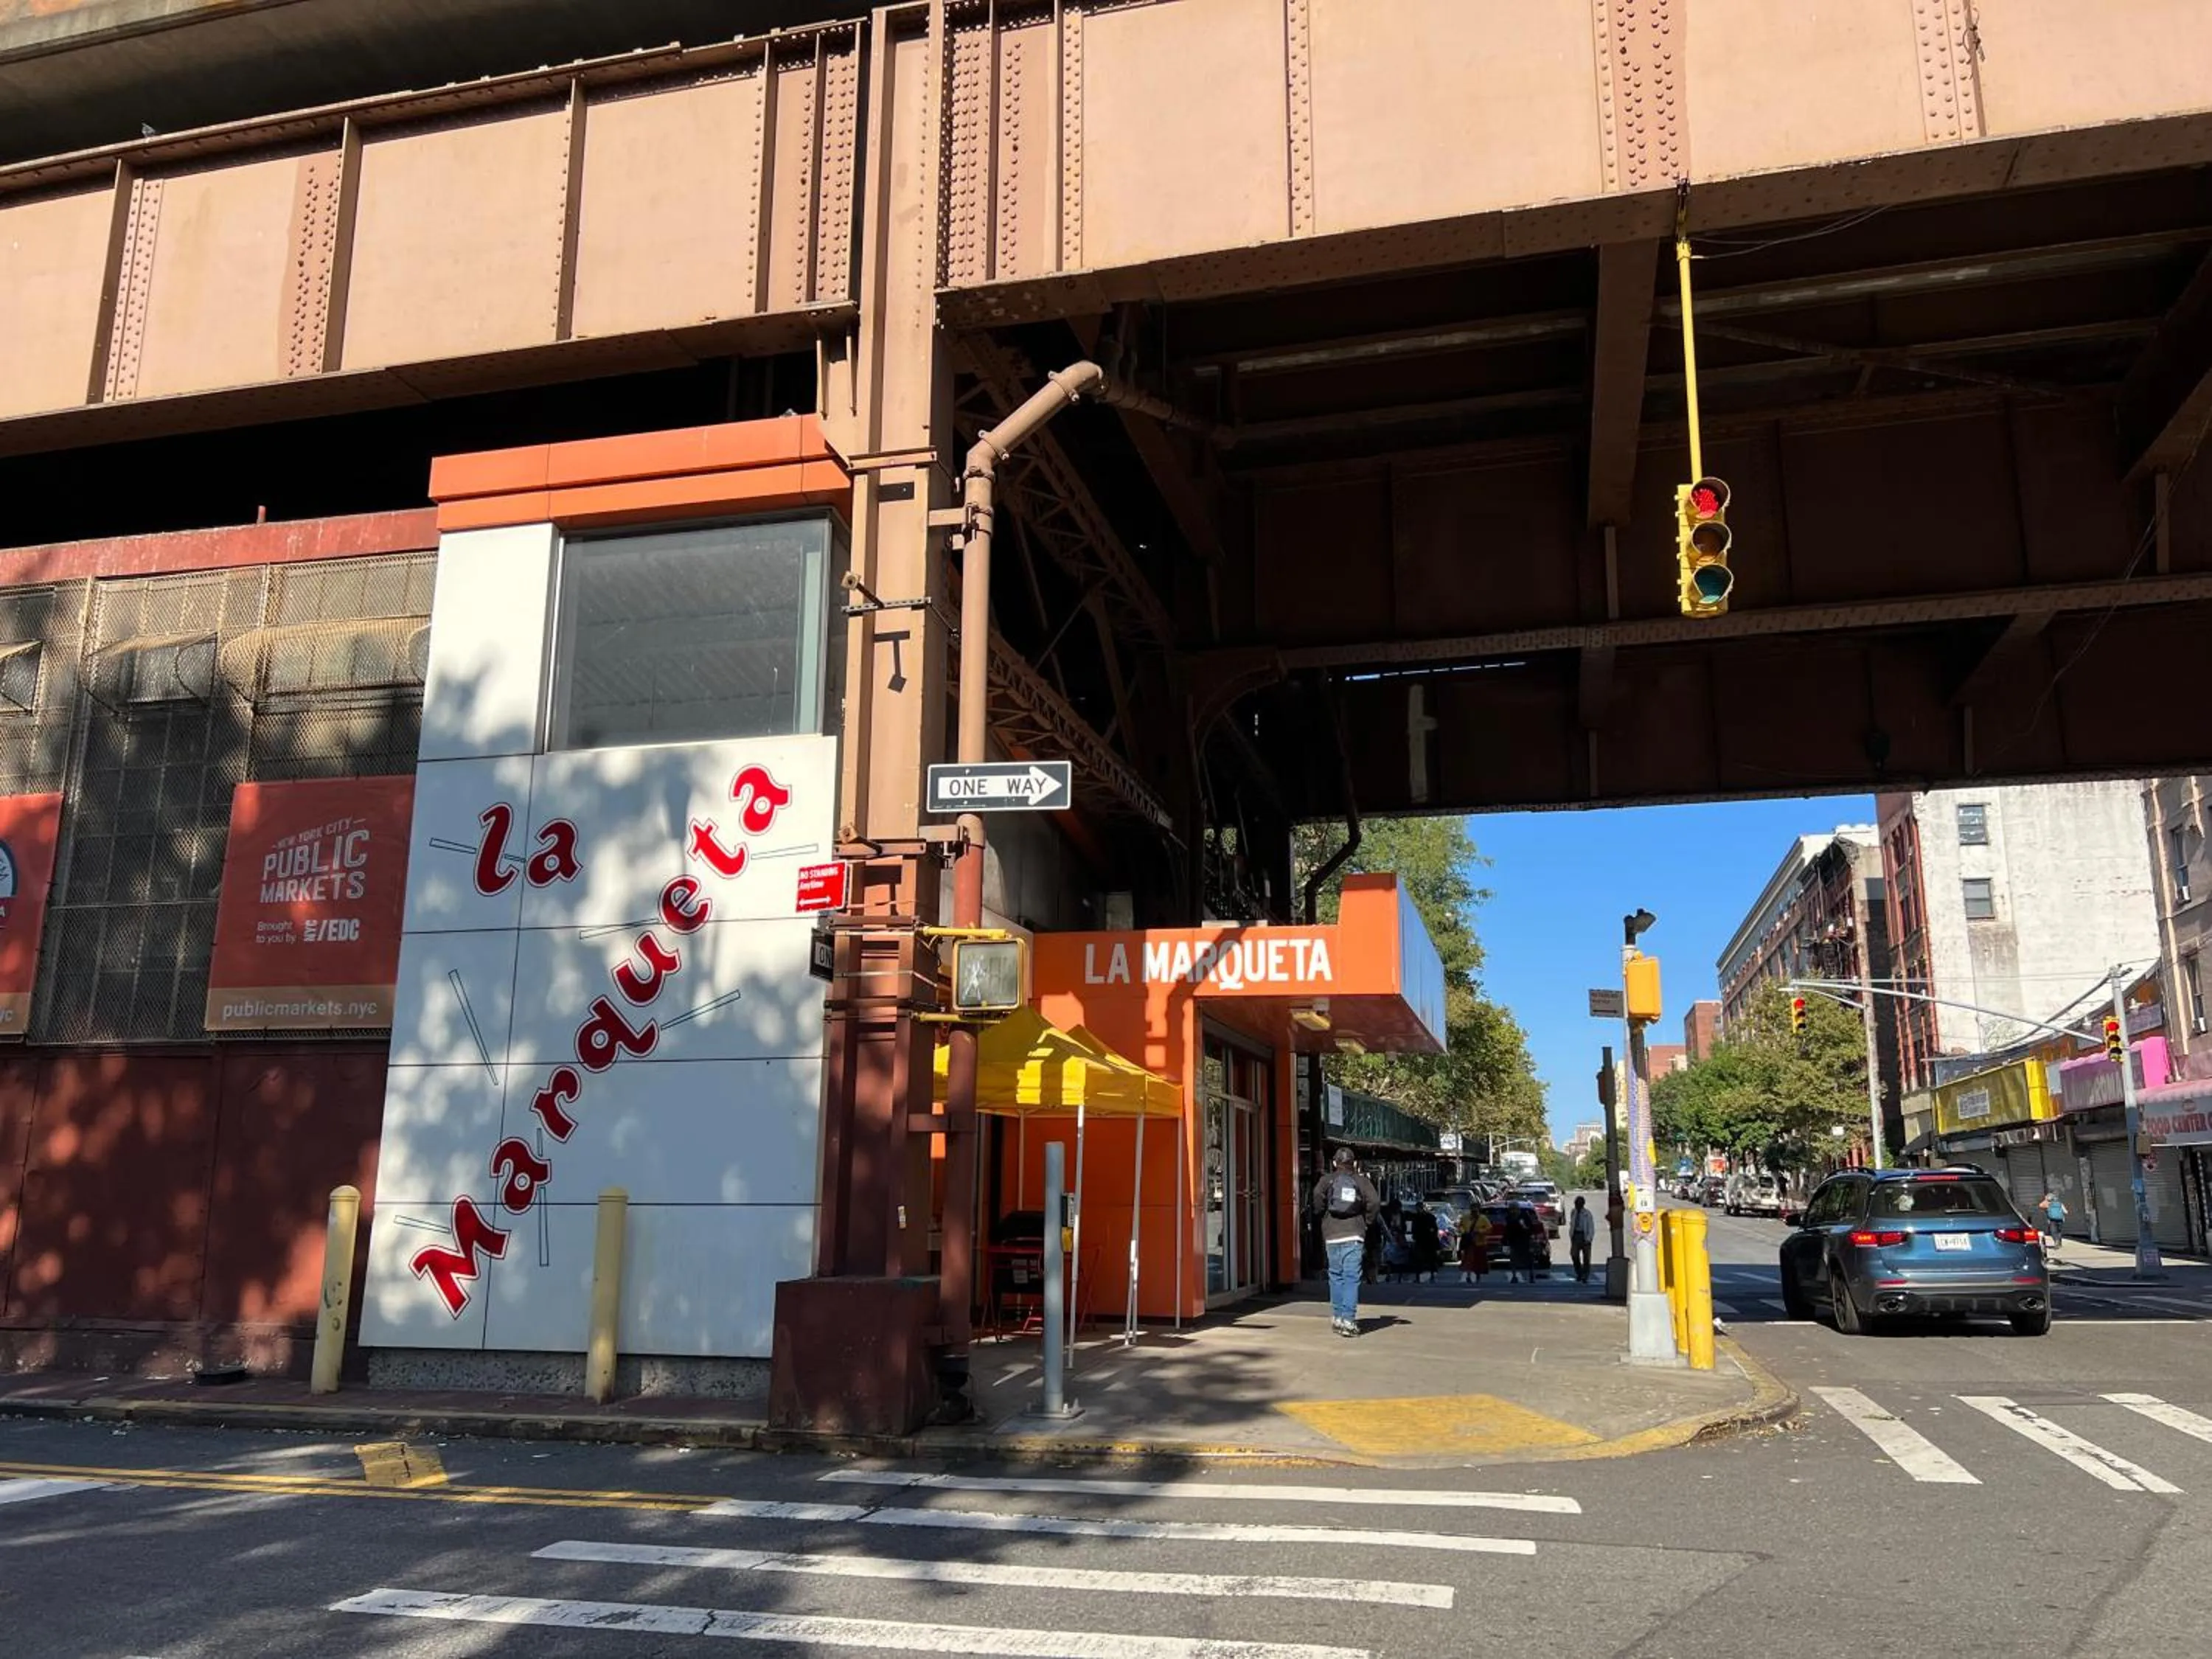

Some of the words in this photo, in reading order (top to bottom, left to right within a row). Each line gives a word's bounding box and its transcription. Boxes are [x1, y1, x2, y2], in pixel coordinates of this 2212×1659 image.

[948, 779, 988, 796] ONE
[1007, 778, 1047, 794] WAY
[298, 826, 323, 843] YORK
[326, 816, 352, 835] CITY
[262, 829, 369, 880] PUBLIC
[260, 871, 366, 903] MARKETS
[257, 921, 293, 933] Brought
[266, 935, 284, 945] you
[286, 932, 296, 945] by
[1084, 942, 1130, 984] LA
[1141, 938, 1333, 990] MARQUETA
[223, 1000, 378, 1020] publicmarkets.nyc
[409, 763, 791, 1319] Marqueta
